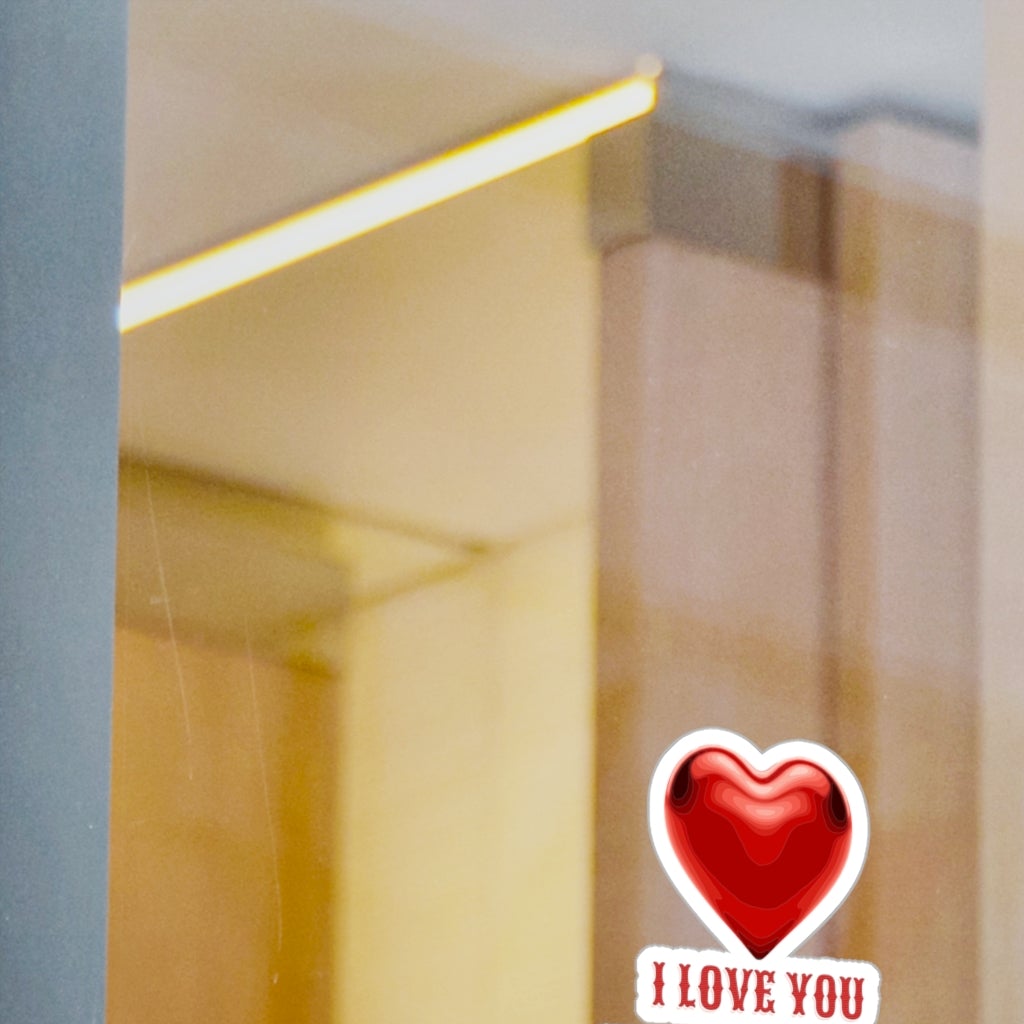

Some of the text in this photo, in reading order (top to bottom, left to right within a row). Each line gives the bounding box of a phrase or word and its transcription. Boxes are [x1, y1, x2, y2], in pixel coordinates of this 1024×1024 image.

[652, 961, 865, 1021] I LOVE YOU
